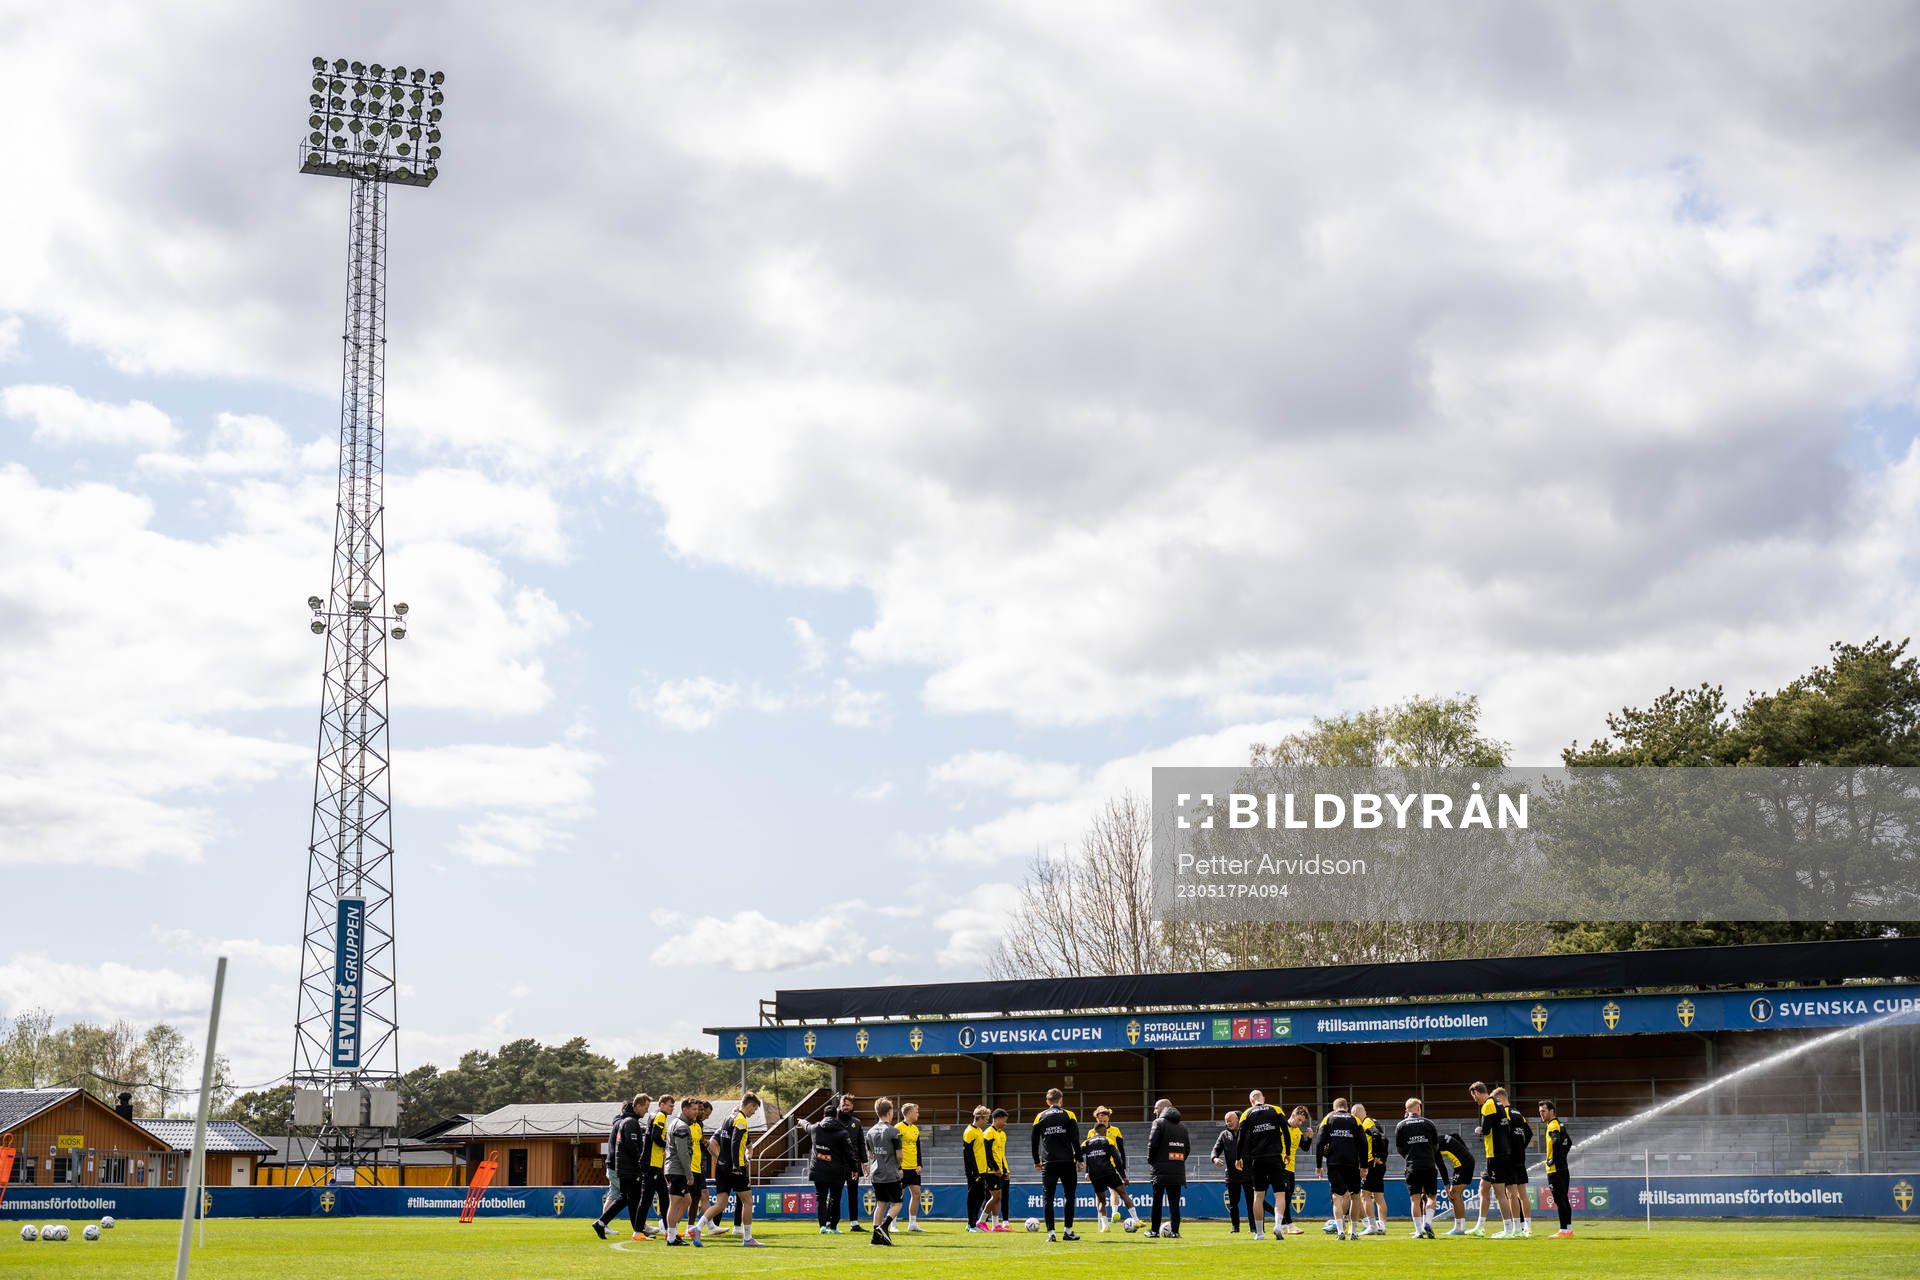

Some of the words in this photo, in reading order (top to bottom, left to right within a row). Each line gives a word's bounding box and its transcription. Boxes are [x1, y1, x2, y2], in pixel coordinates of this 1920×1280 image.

[345, 907, 359, 982] GRUPPEN
[1779, 1000, 1869, 1016] SVENSKA
[338, 984, 356, 1060] LEVINS
[1144, 1021, 1201, 1032] FOTBOLLEN
[1317, 1014, 1488, 1033] #tillsammansförfotbollen
[981, 1029, 1047, 1044] SVENSKA
[1051, 1027, 1102, 1041] CUPEN
[1144, 1030, 1201, 1042] SAMHÄLLET
[60, 1137, 81, 1146] KIOSK
[0, 1197, 116, 1210] ammansförfotbollen
[1638, 1188, 1842, 1205] #tillsammansförfotbollen
